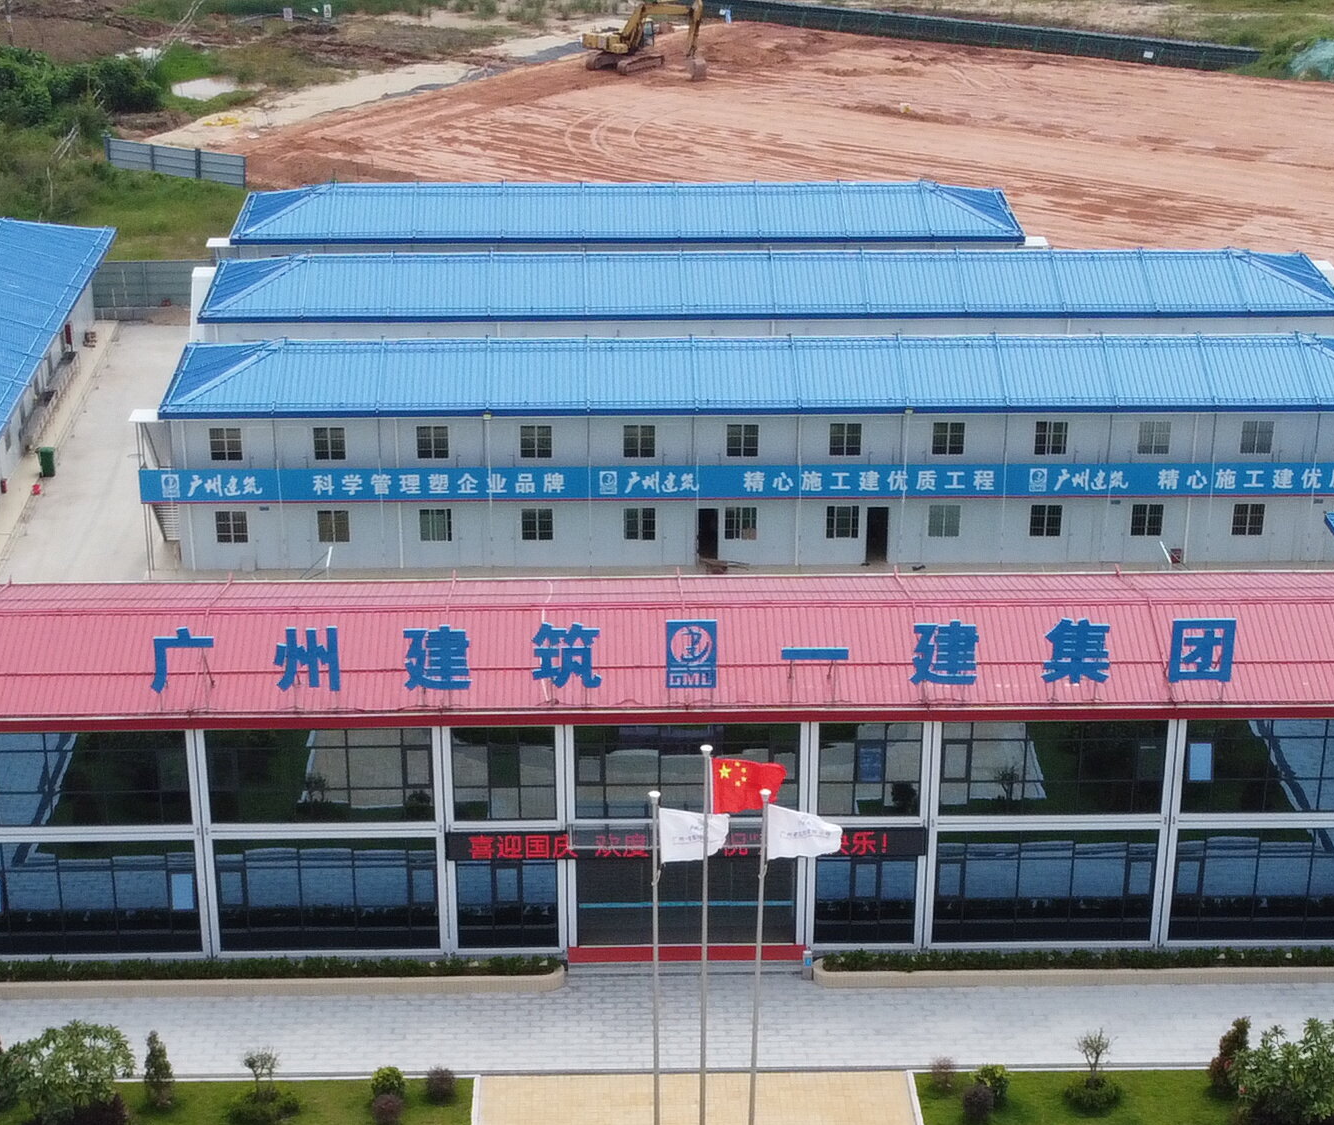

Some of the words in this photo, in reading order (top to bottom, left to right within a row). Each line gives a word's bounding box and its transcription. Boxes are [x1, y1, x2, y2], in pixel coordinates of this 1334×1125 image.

[187, 474, 263, 497] 广州建筑
[312, 473, 565, 495] 科学管理塑企业品牌
[624, 471, 700, 494] 广州建筑
[743, 470, 995, 492] 精心施工建优质工程
[1053, 469, 1129, 492] 广州建筑
[151, 622, 602, 693] 广州建筑
[781, 617, 1237, 685] 一建集团
[469, 834, 578, 859] 喜迎国庆
